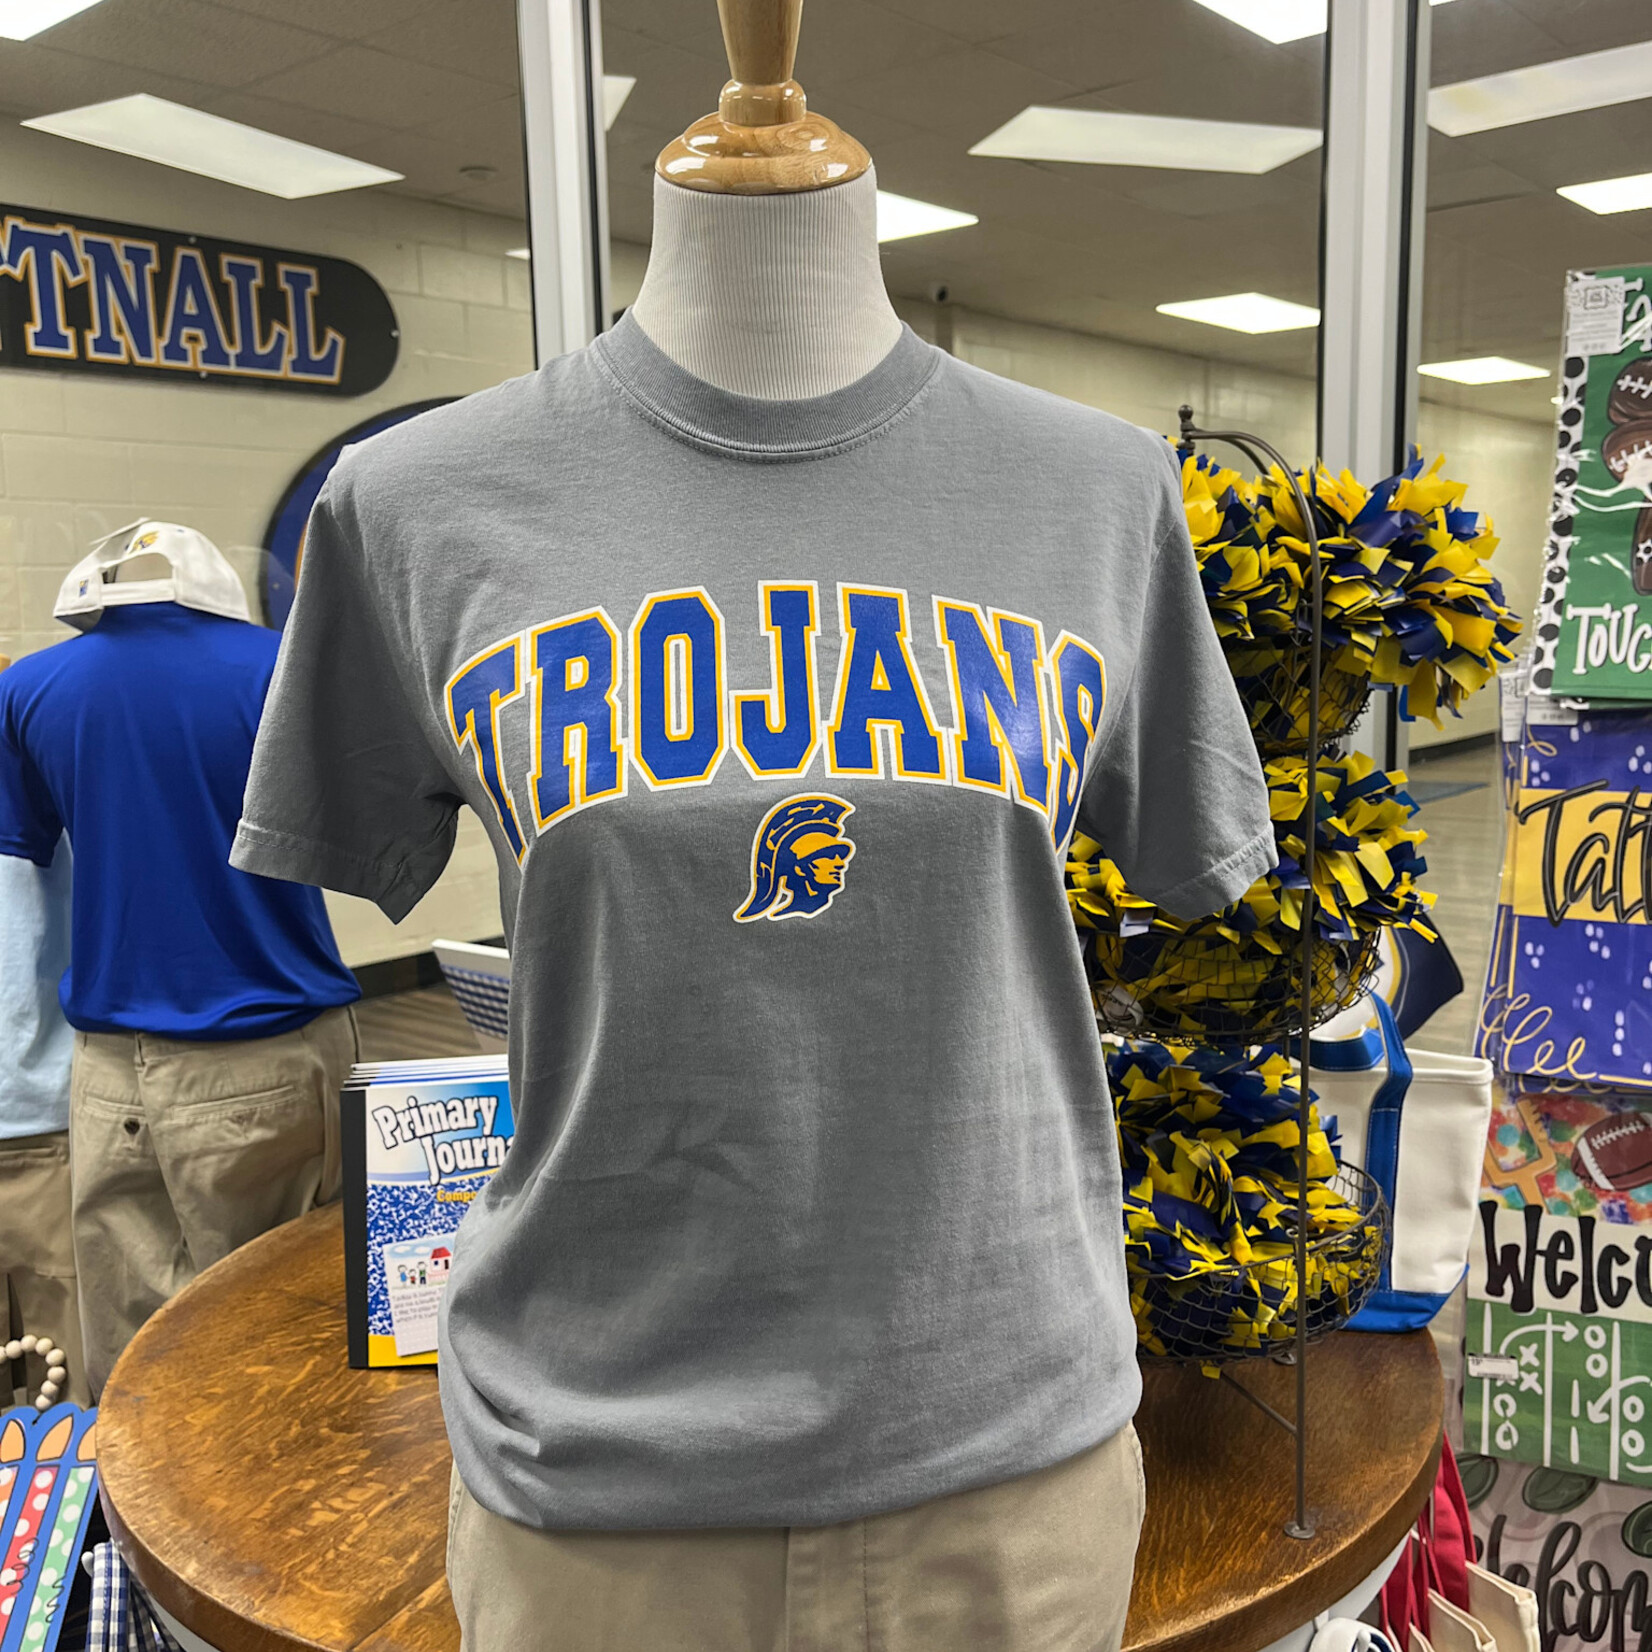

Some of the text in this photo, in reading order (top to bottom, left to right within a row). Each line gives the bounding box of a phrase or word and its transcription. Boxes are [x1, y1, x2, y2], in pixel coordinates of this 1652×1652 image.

[0, 214, 345, 385] TNALL
[1566, 602, 1652, 675] TOUC
[444, 580, 1107, 871] TROJANS
[372, 1095, 499, 1150] Primary
